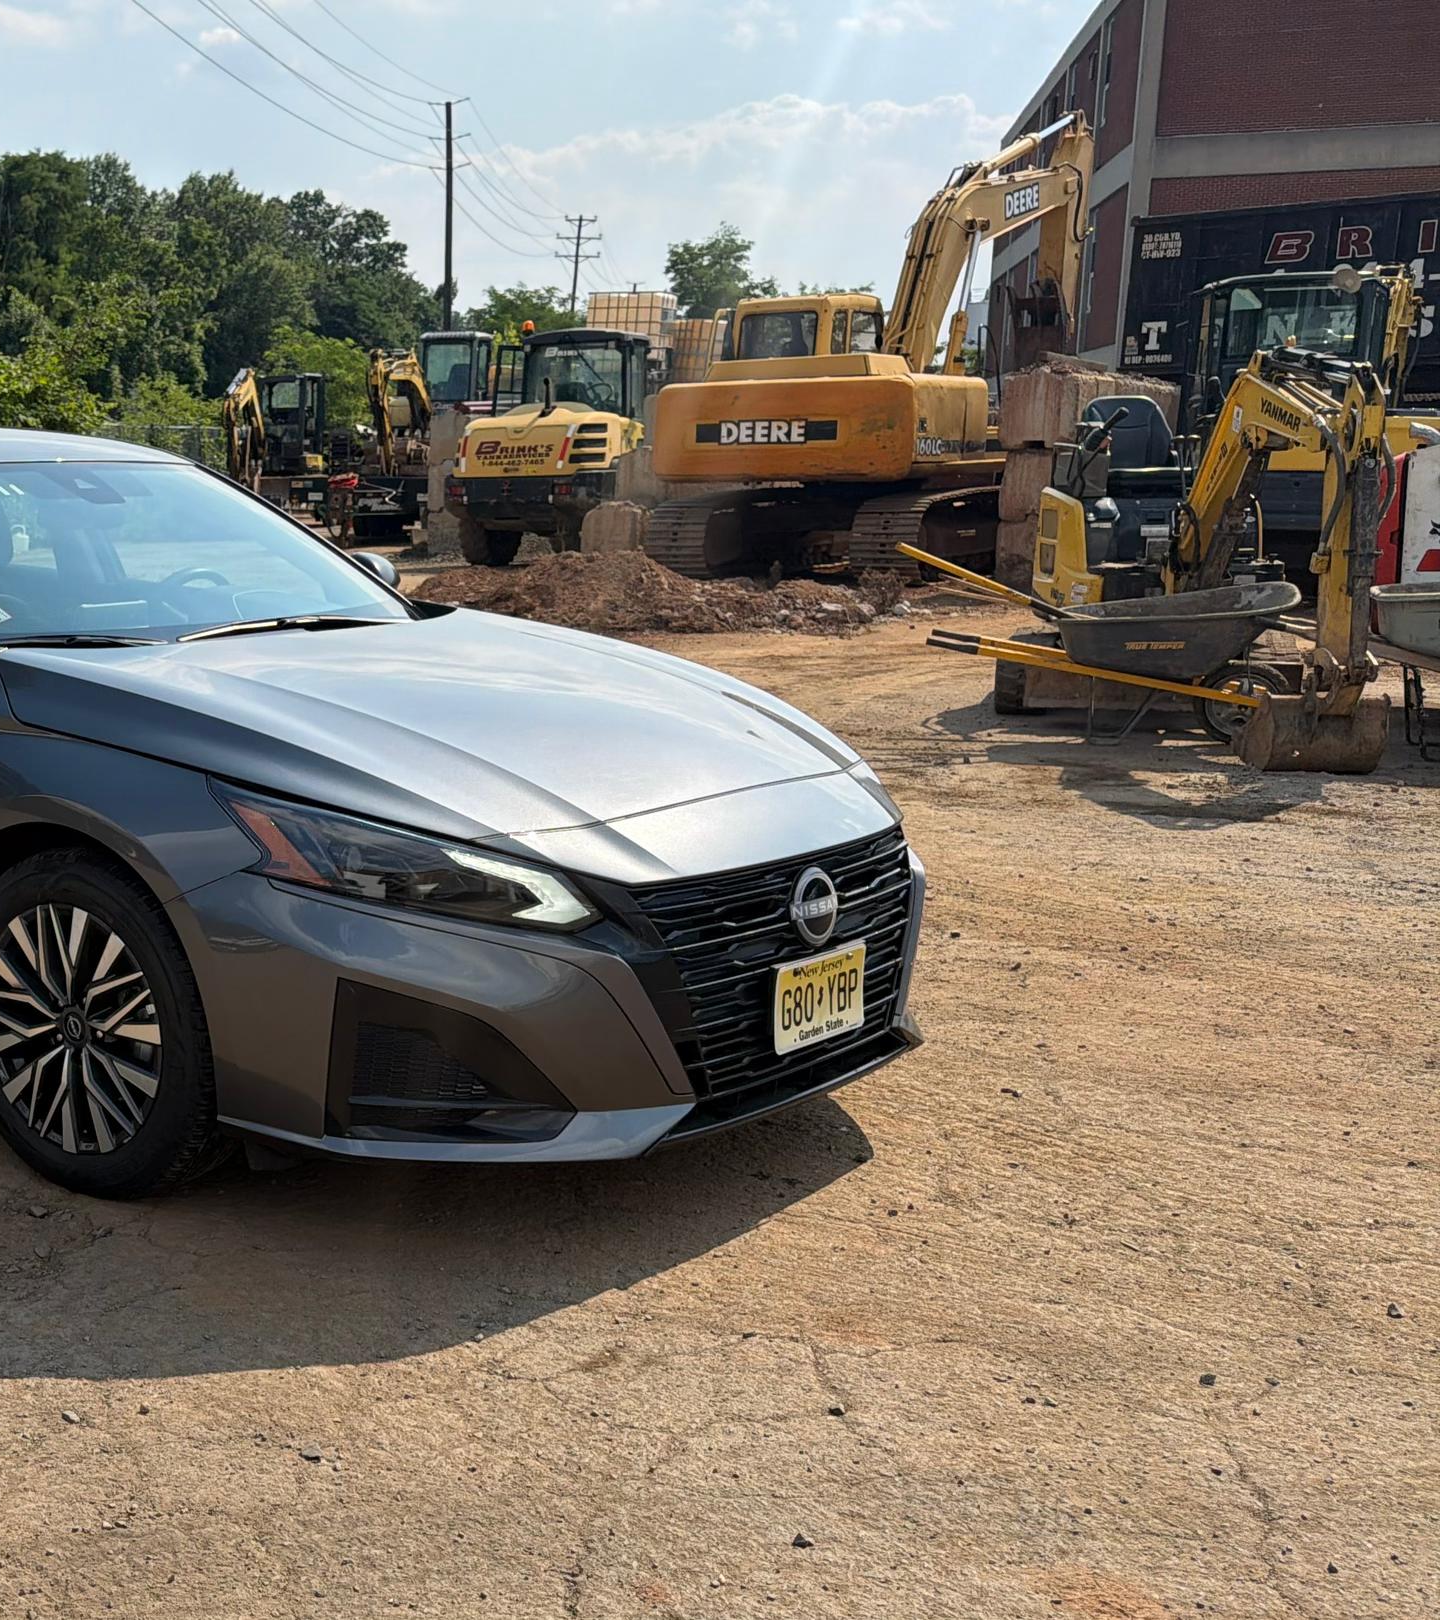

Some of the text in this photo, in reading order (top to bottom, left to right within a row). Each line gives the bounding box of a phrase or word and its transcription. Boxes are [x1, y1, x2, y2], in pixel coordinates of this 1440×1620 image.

[1005, 183, 1039, 219] DEERE
[1260, 397, 1301, 433] YANMAR
[720, 420, 806, 443] DEERE
[475, 441, 554, 455] BRINK'S
[799, 958, 844, 979] New Jersey
[799, 1017, 844, 1041] Garden State
